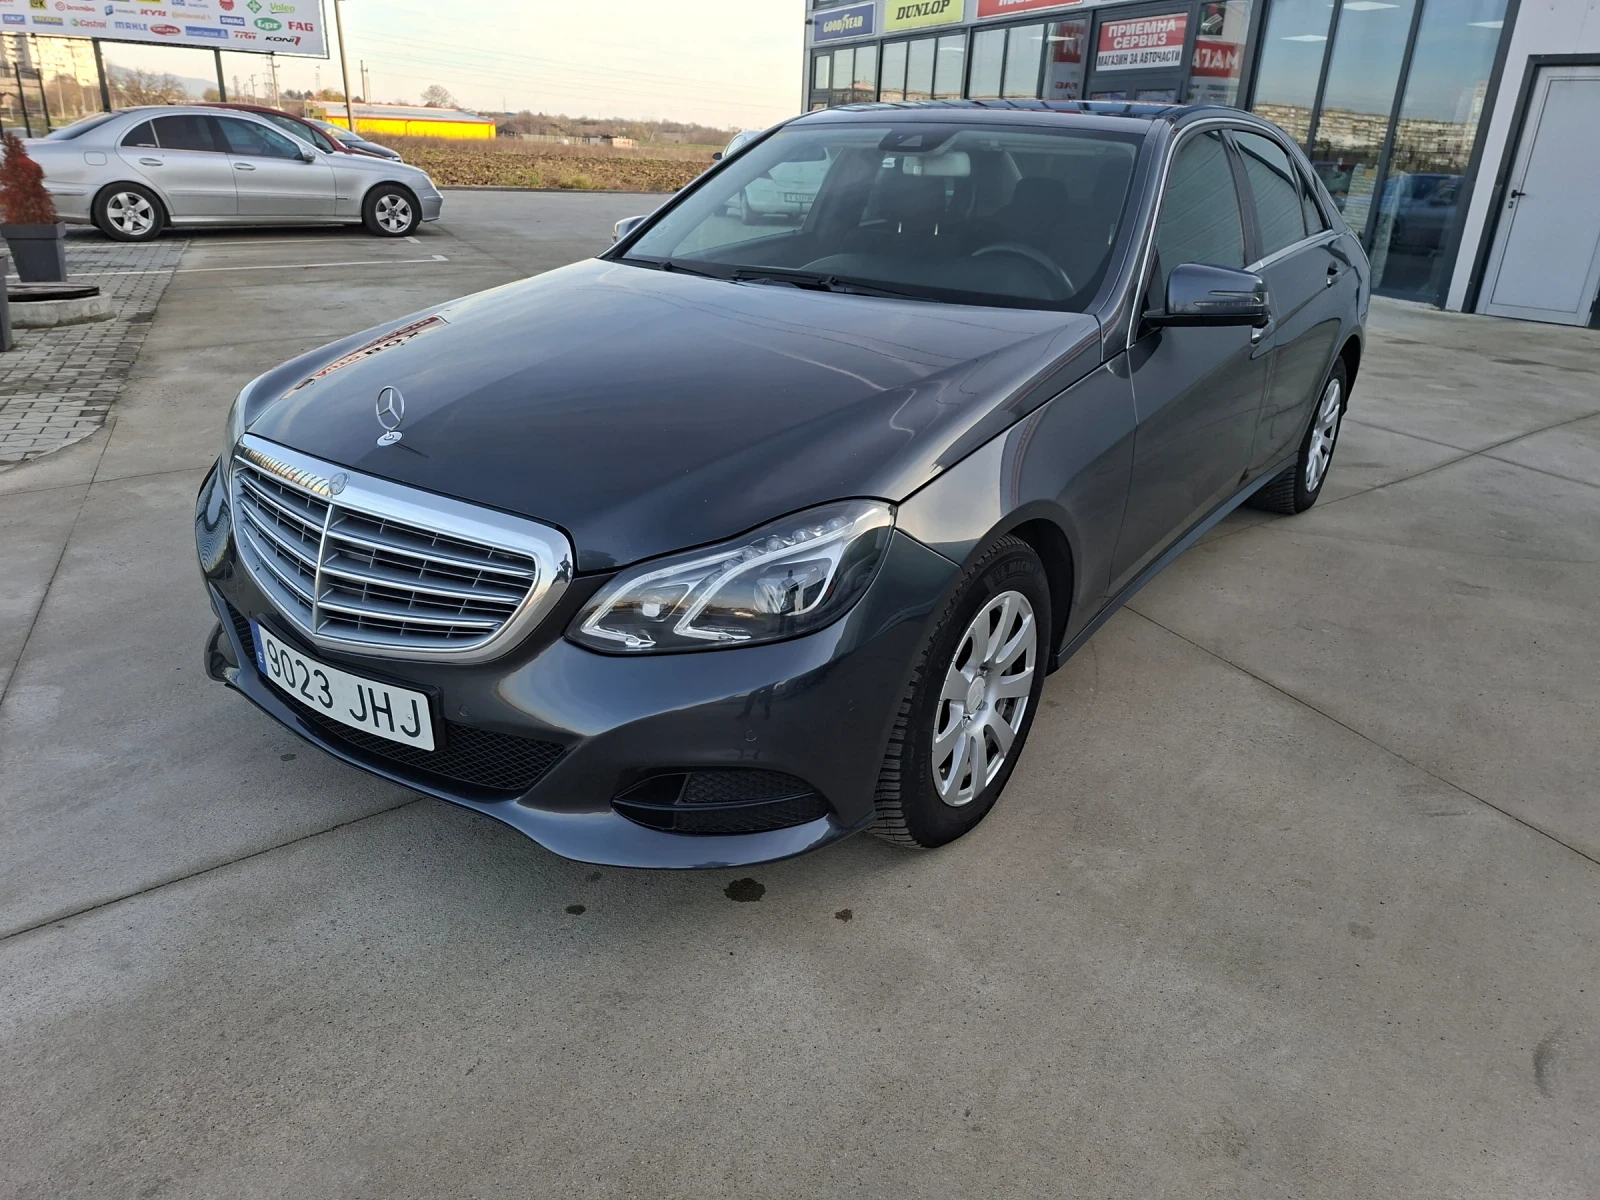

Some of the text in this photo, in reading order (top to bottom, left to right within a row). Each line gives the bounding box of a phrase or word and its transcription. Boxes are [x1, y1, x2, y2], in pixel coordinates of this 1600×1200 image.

[896, 0, 951, 20] DUNLOP
[80, 20, 107, 29] Castrol
[115, 21, 149, 31] MAHLE
[221, 17, 244, 25] SWAG
[288, 21, 314, 32] FAG
[823, 14, 864, 33] GOODYEAR
[1108, 19, 1177, 38] ПРИЕМНА
[1113, 32, 1167, 49] СЕРВИЗ
[1097, 50, 1180, 67] МАГАЗИН ЗА АВТОЧАСТИ
[257, 651, 264, 663] E
[266, 638, 421, 738] 9023 JHJ
